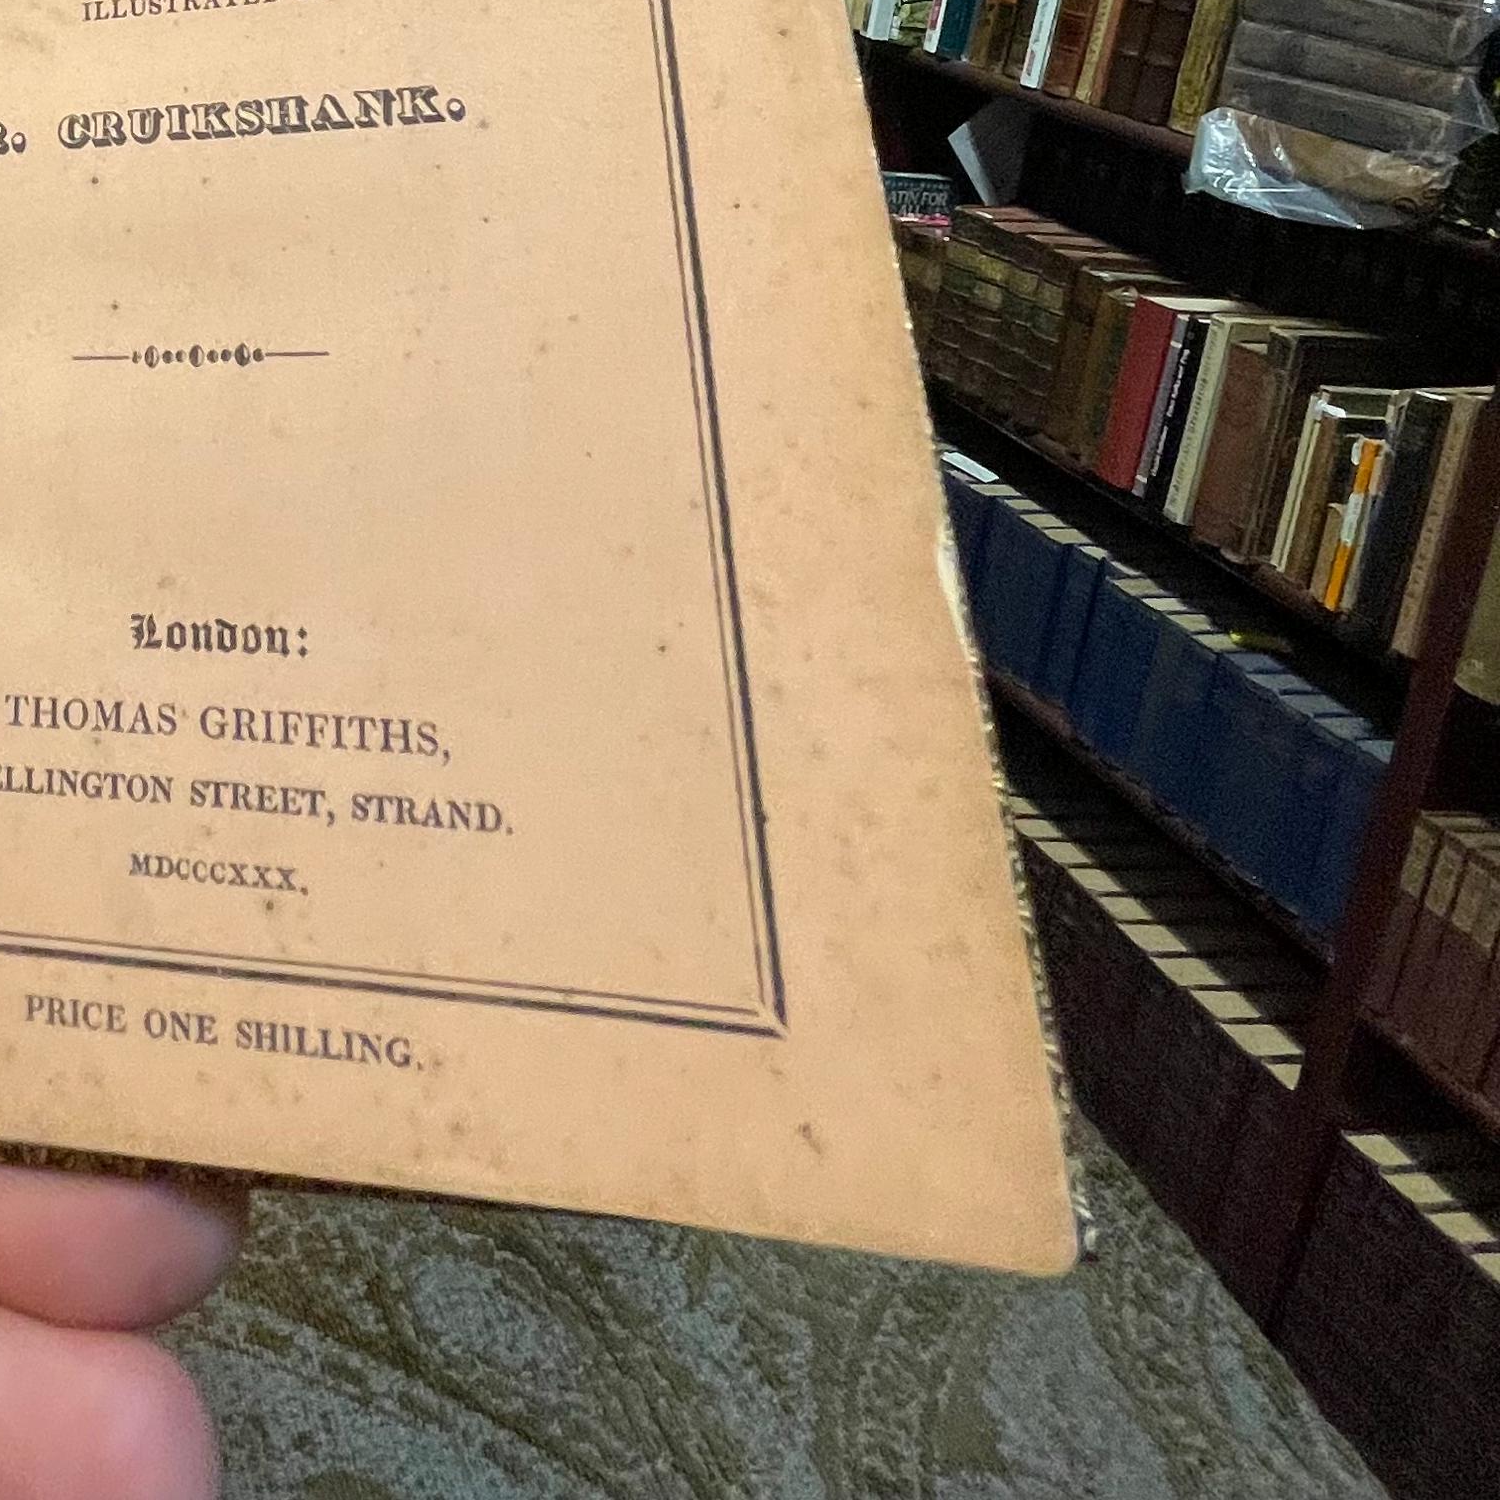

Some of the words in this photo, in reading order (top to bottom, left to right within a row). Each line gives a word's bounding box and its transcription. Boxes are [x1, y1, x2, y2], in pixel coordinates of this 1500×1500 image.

[57, 84, 467, 150] CRUIKSHANK.
[129, 612, 308, 659] London:
[4, 694, 178, 736] THOMAS
[199, 705, 451, 767] GRIFFITHS,
[189, 779, 336, 828] STREET,
[351, 792, 514, 836] STRAND.
[128, 852, 309, 896] MDCCCXXX.
[24, 994, 127, 1034] PRICE
[143, 1008, 219, 1046] ONE
[235, 1019, 424, 1071] SHILLING.
